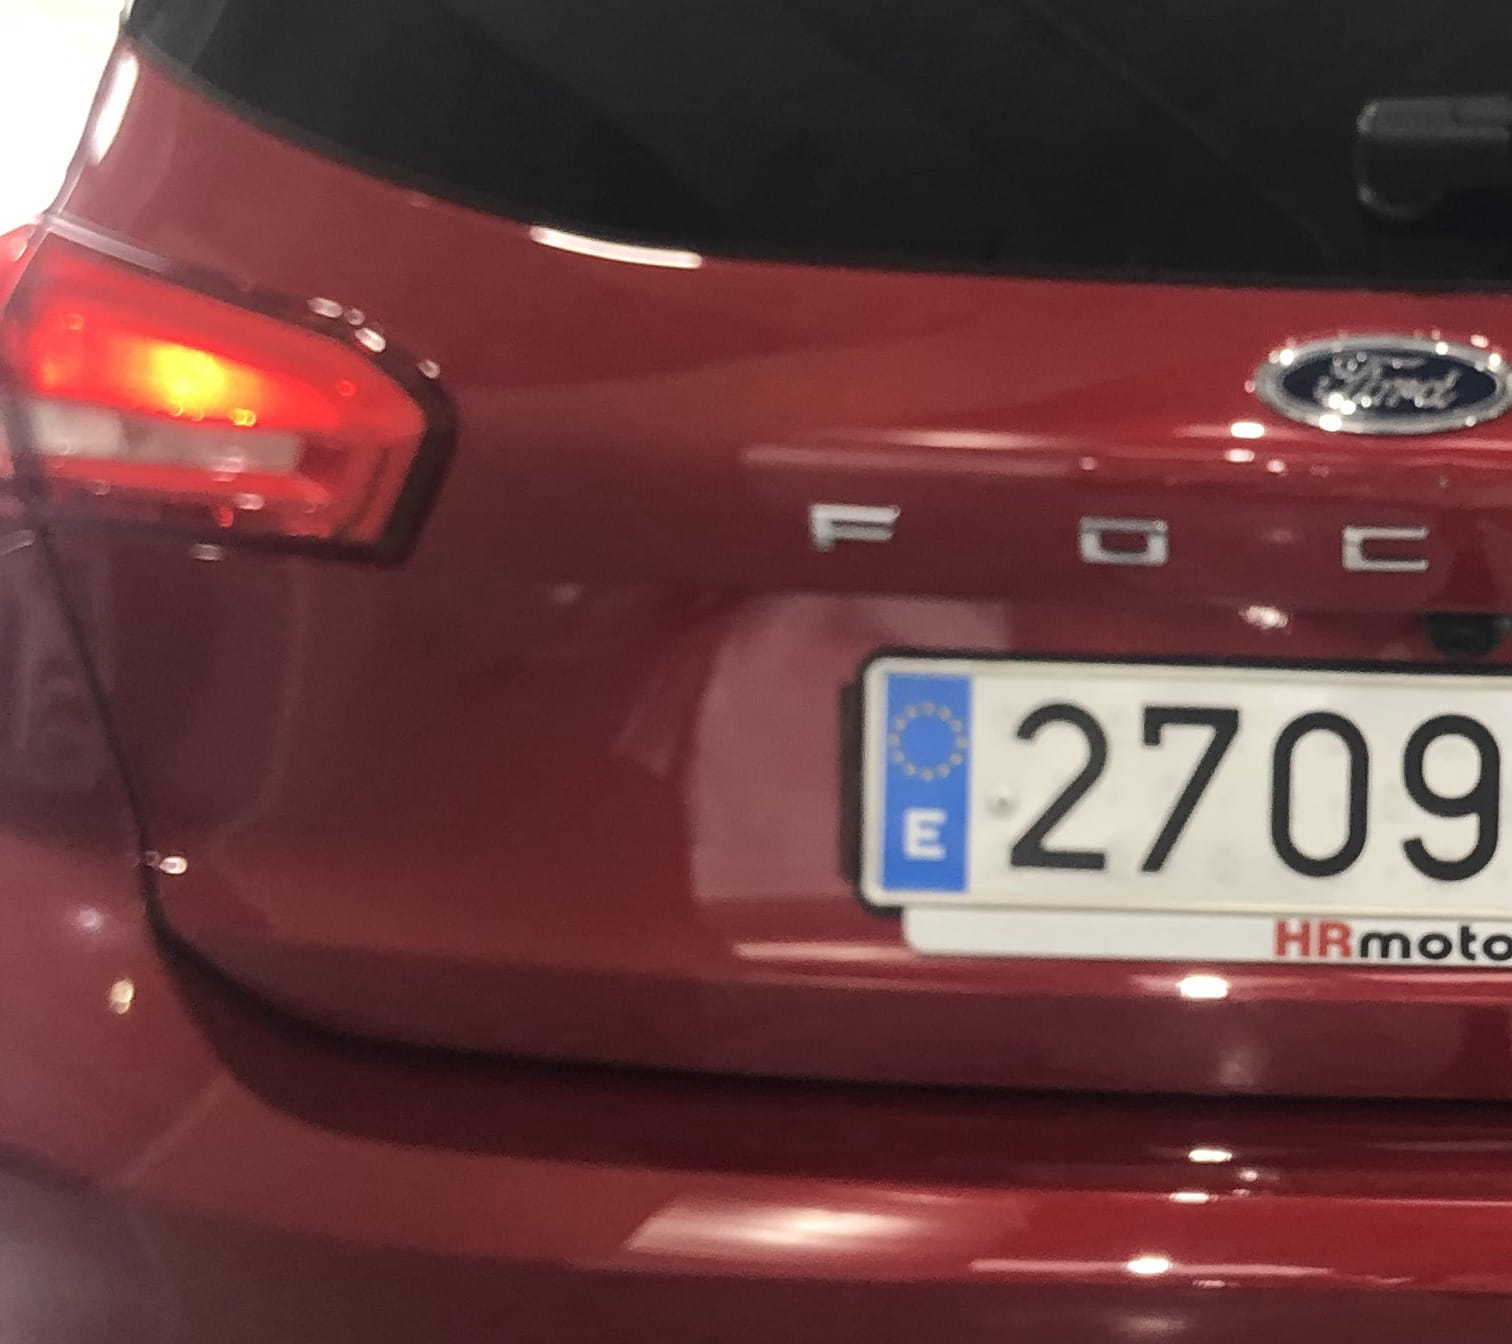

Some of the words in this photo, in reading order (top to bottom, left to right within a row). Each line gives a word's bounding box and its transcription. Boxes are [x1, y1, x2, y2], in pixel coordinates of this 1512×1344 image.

[1312, 352, 1459, 411] Ford
[904, 807, 946, 861] E
[1010, 702, 1503, 882] 2709
